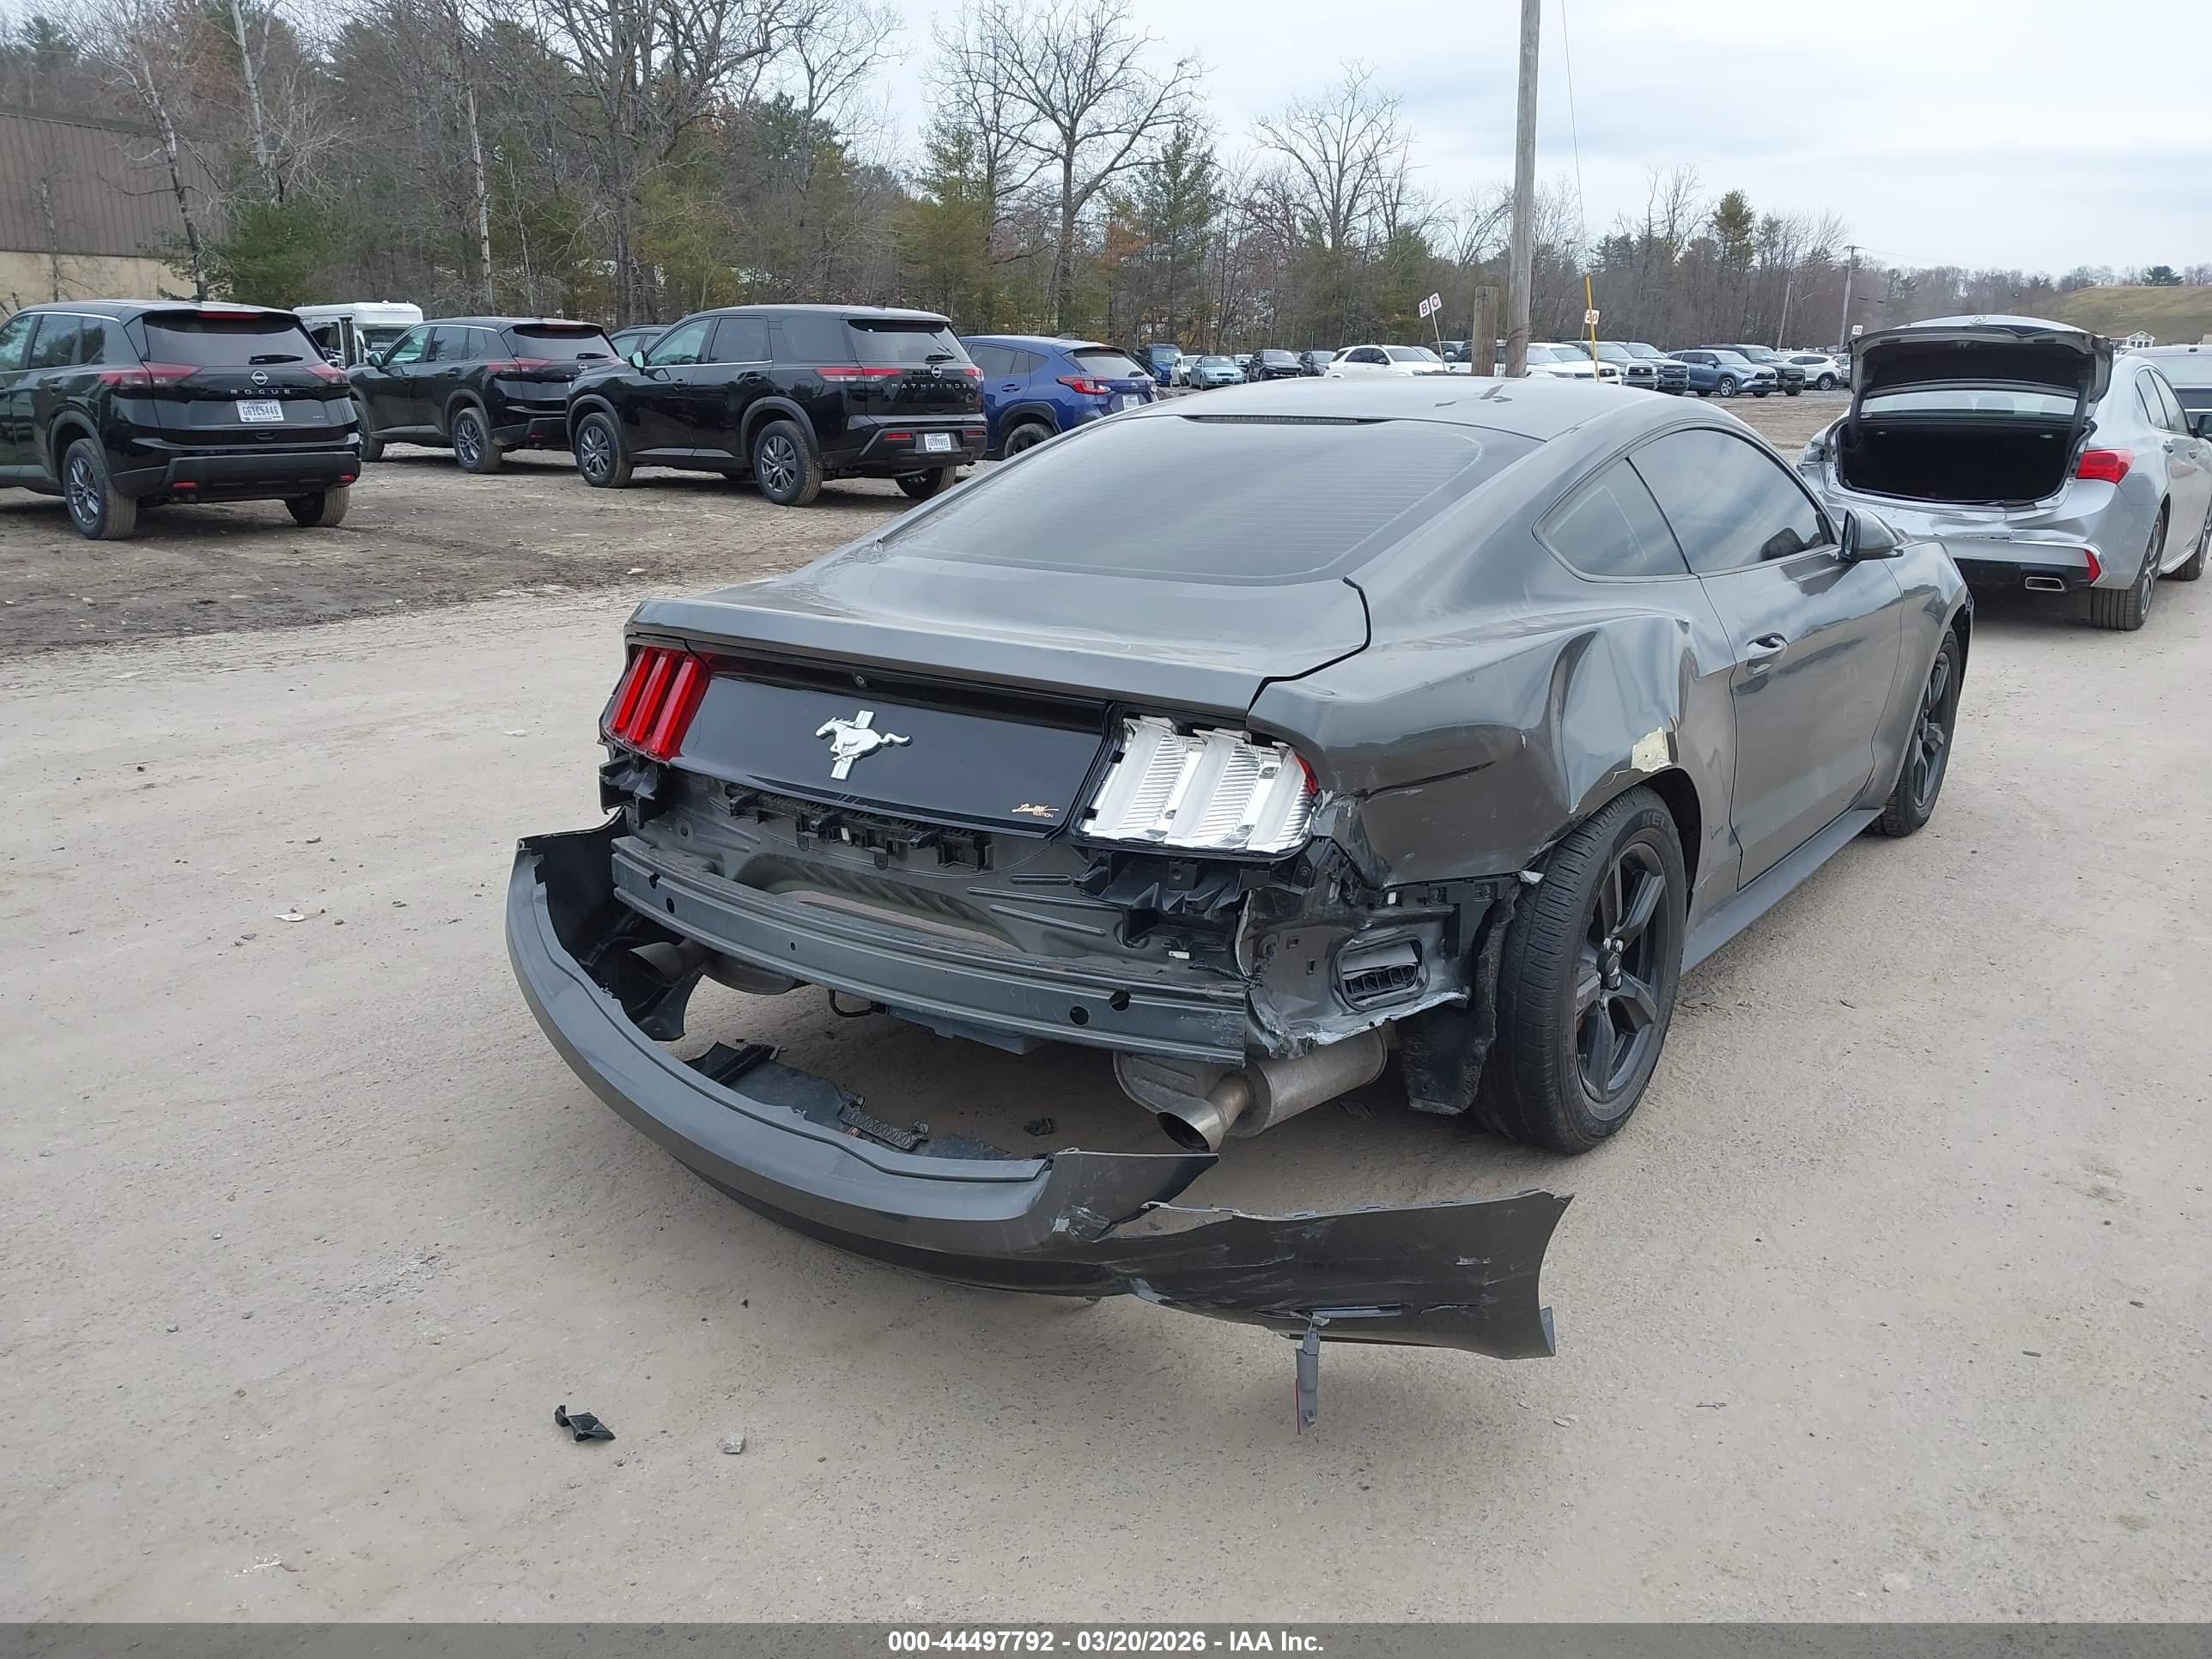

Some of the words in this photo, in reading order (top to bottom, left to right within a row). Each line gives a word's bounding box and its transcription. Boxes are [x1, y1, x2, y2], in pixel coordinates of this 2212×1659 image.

[1431, 296, 1439, 307] C
[1421, 302, 1428, 314] B
[1586, 313, 1598, 322] 20
